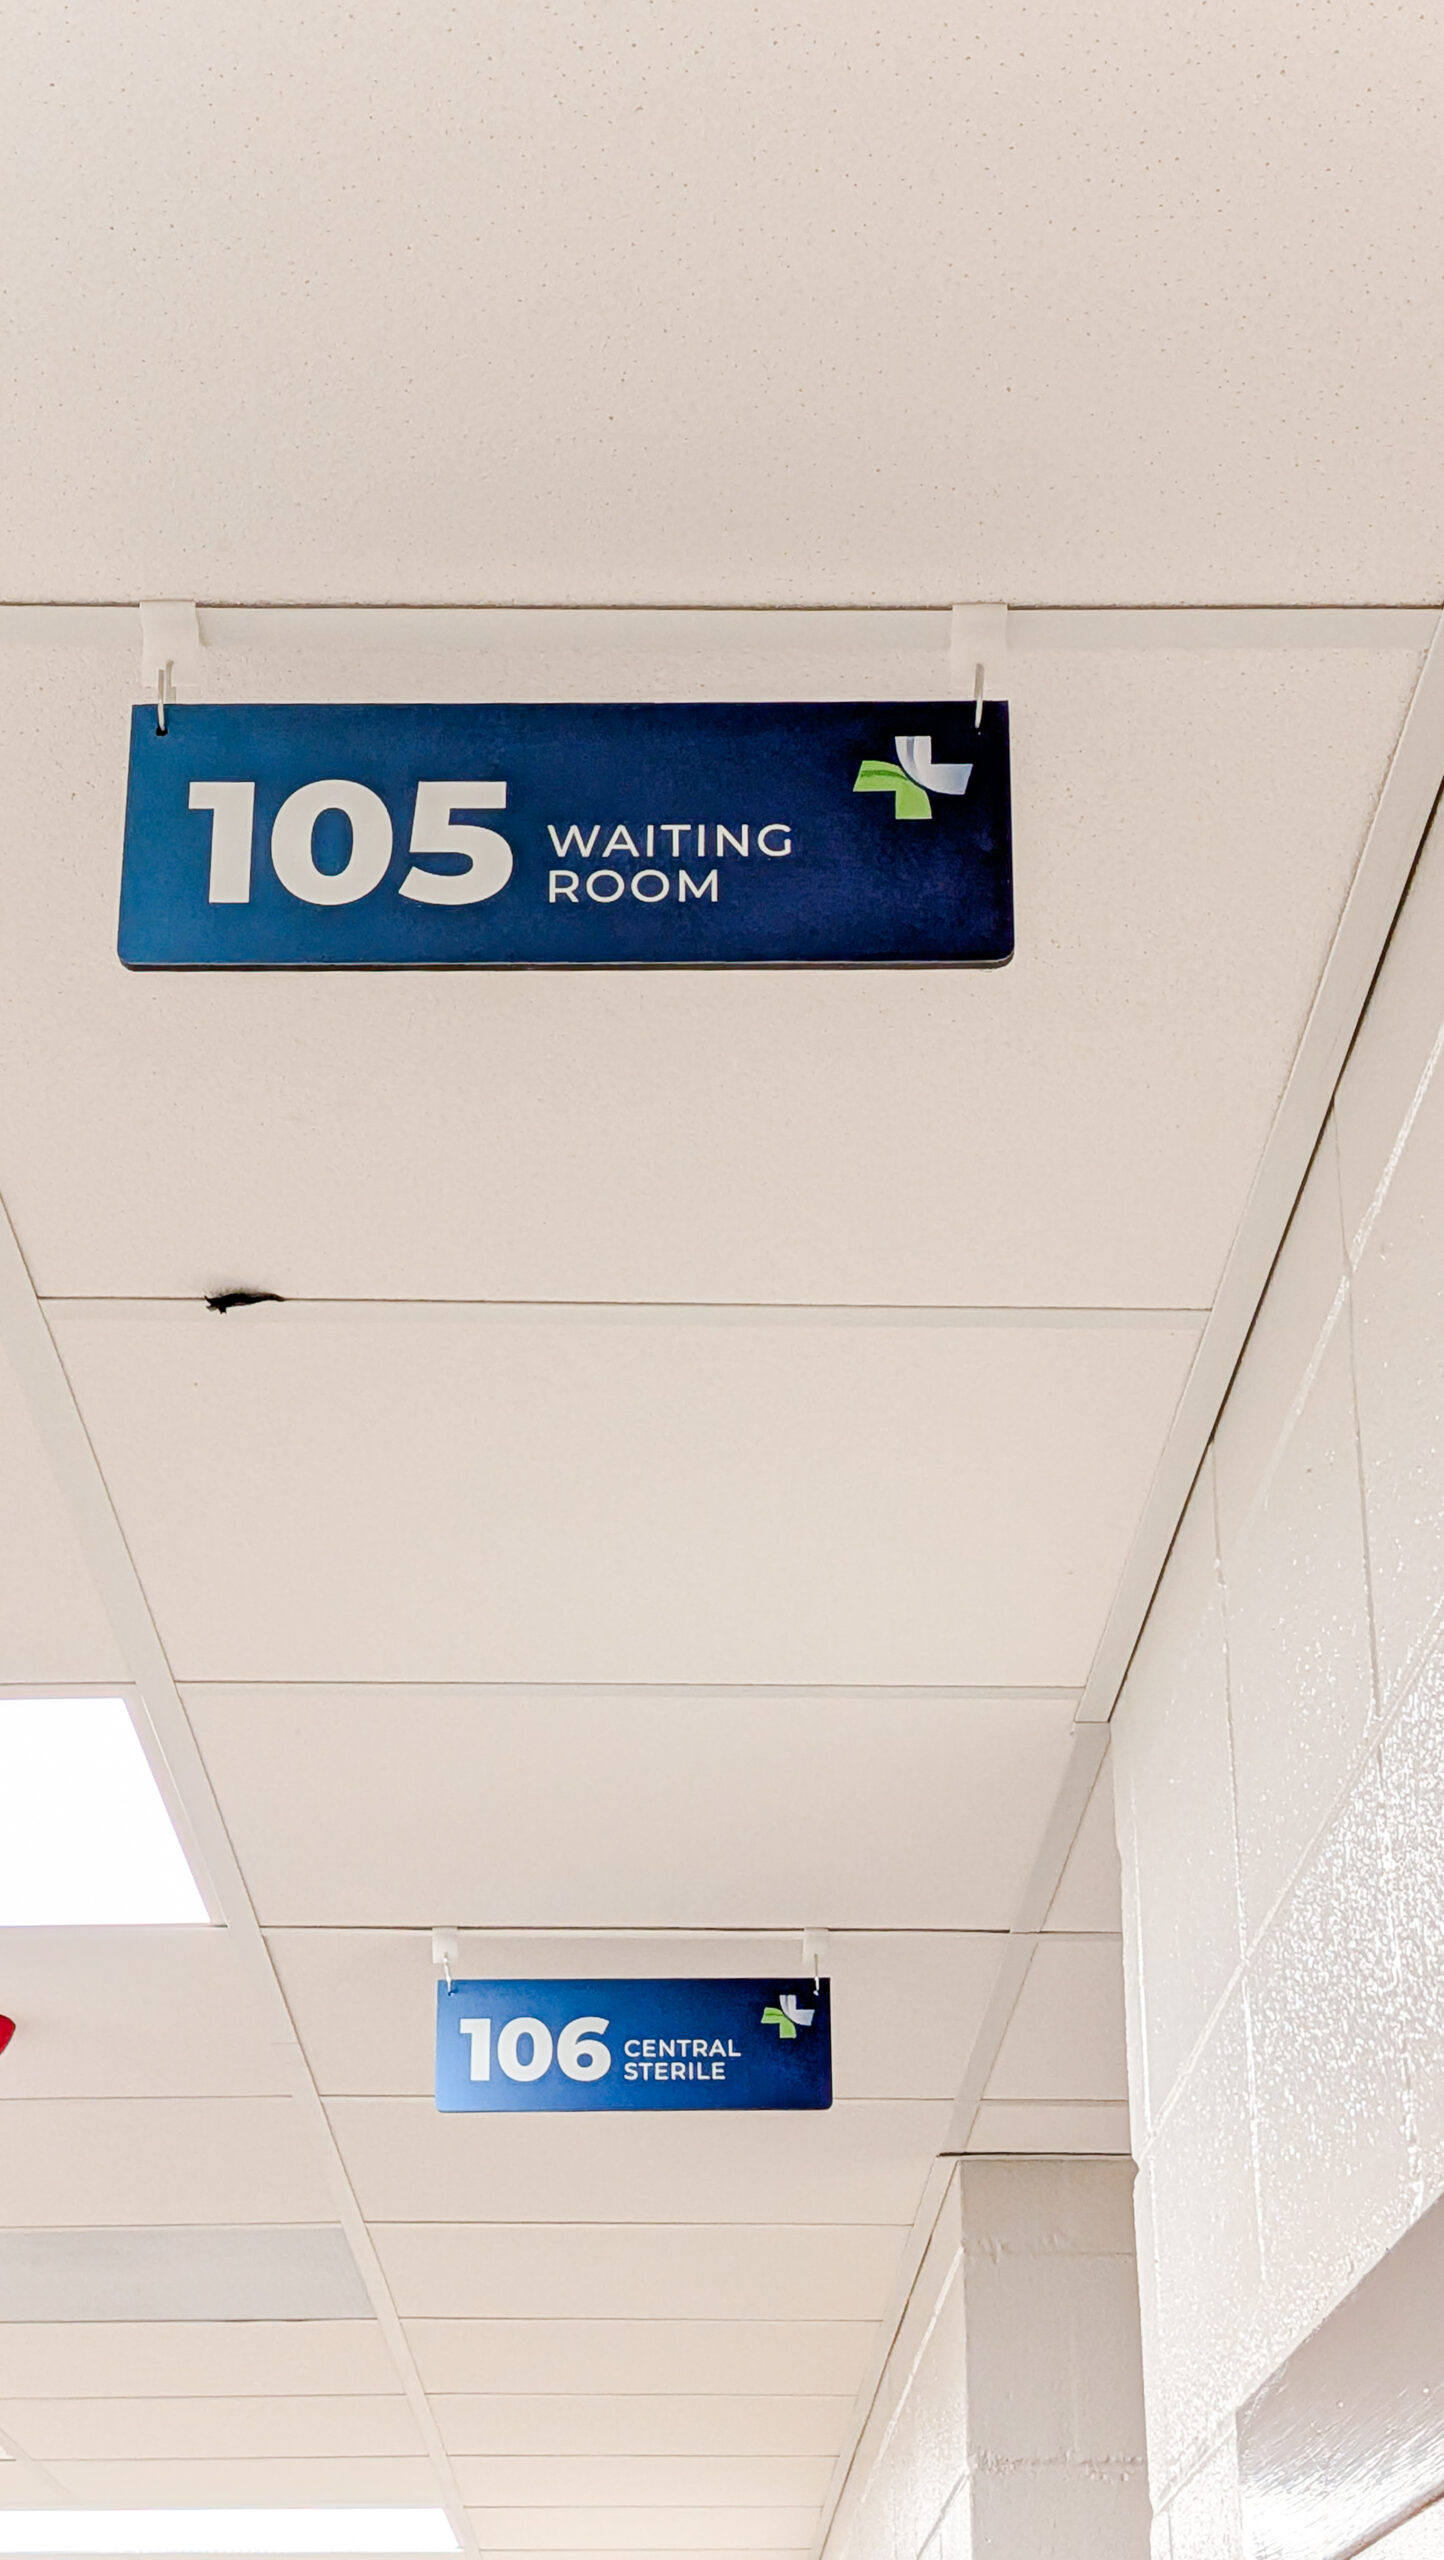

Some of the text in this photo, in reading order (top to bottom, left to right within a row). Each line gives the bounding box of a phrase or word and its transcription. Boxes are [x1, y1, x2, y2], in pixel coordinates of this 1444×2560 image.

[188, 779, 514, 906] 105
[547, 823, 793, 858] WAITING
[548, 869, 719, 903] ROOM
[459, 2016, 612, 2082] 106
[623, 2039, 742, 2058] CENTRAL
[623, 2061, 726, 2081] STERILE
